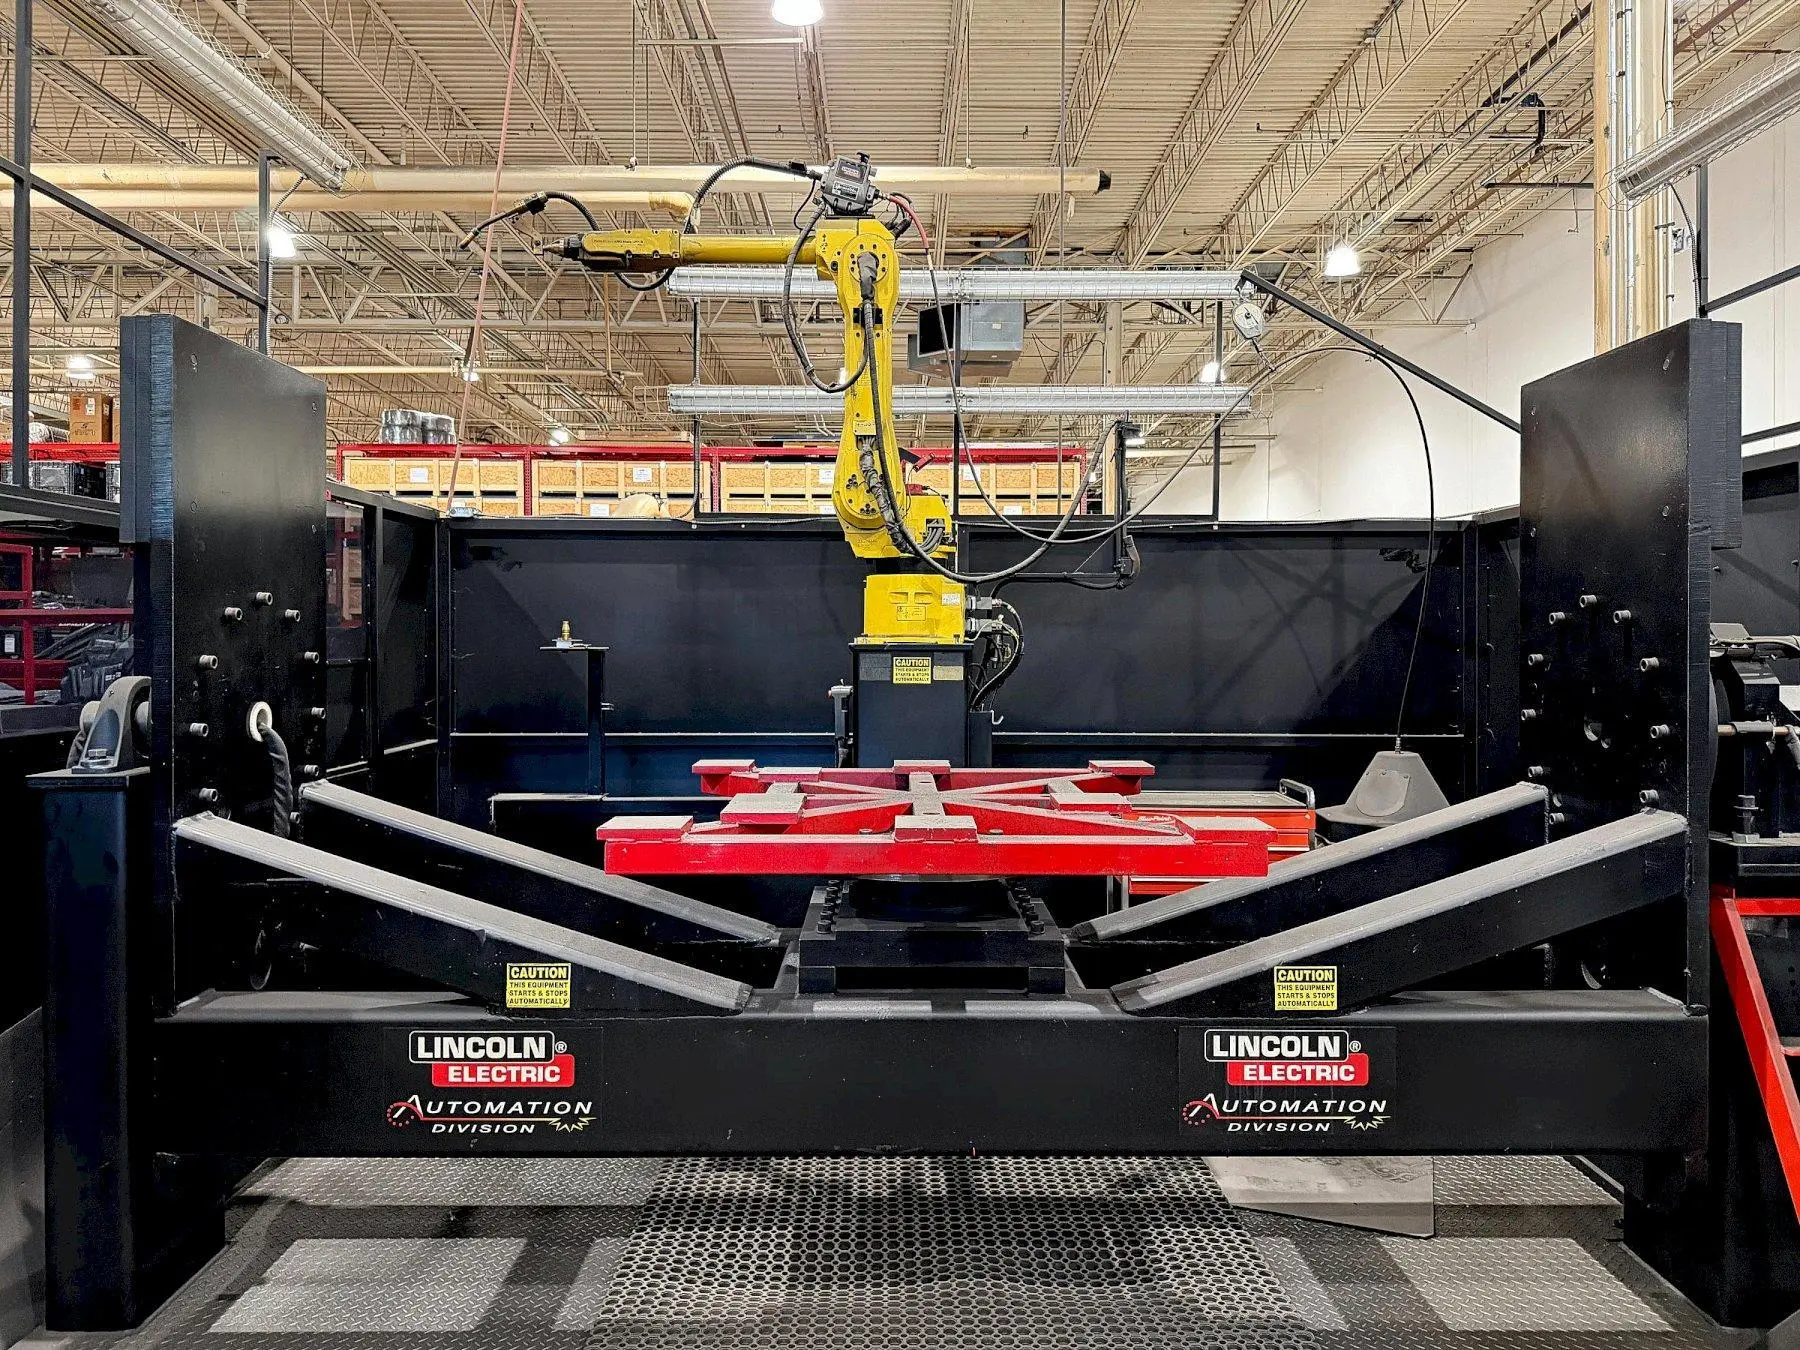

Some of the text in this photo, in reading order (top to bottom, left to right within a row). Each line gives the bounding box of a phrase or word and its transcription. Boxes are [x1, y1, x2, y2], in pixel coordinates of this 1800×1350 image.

[511, 966, 567, 979] CAUTION
[1277, 969, 1333, 981] CAUTION
[509, 989, 568, 997] STARTS & STOPS
[417, 1036, 546, 1059] LINCOLN
[1213, 1035, 1340, 1058] LINCOLN
[448, 1065, 561, 1083] ELECTRIC
[1243, 1064, 1355, 1081] ELECTRIC
[393, 1094, 592, 1119] AUTOMATION
[1188, 1093, 1387, 1117] AUTOMATION
[431, 1123, 535, 1134] DIVISION
[1227, 1122, 1330, 1132] DIVISION
